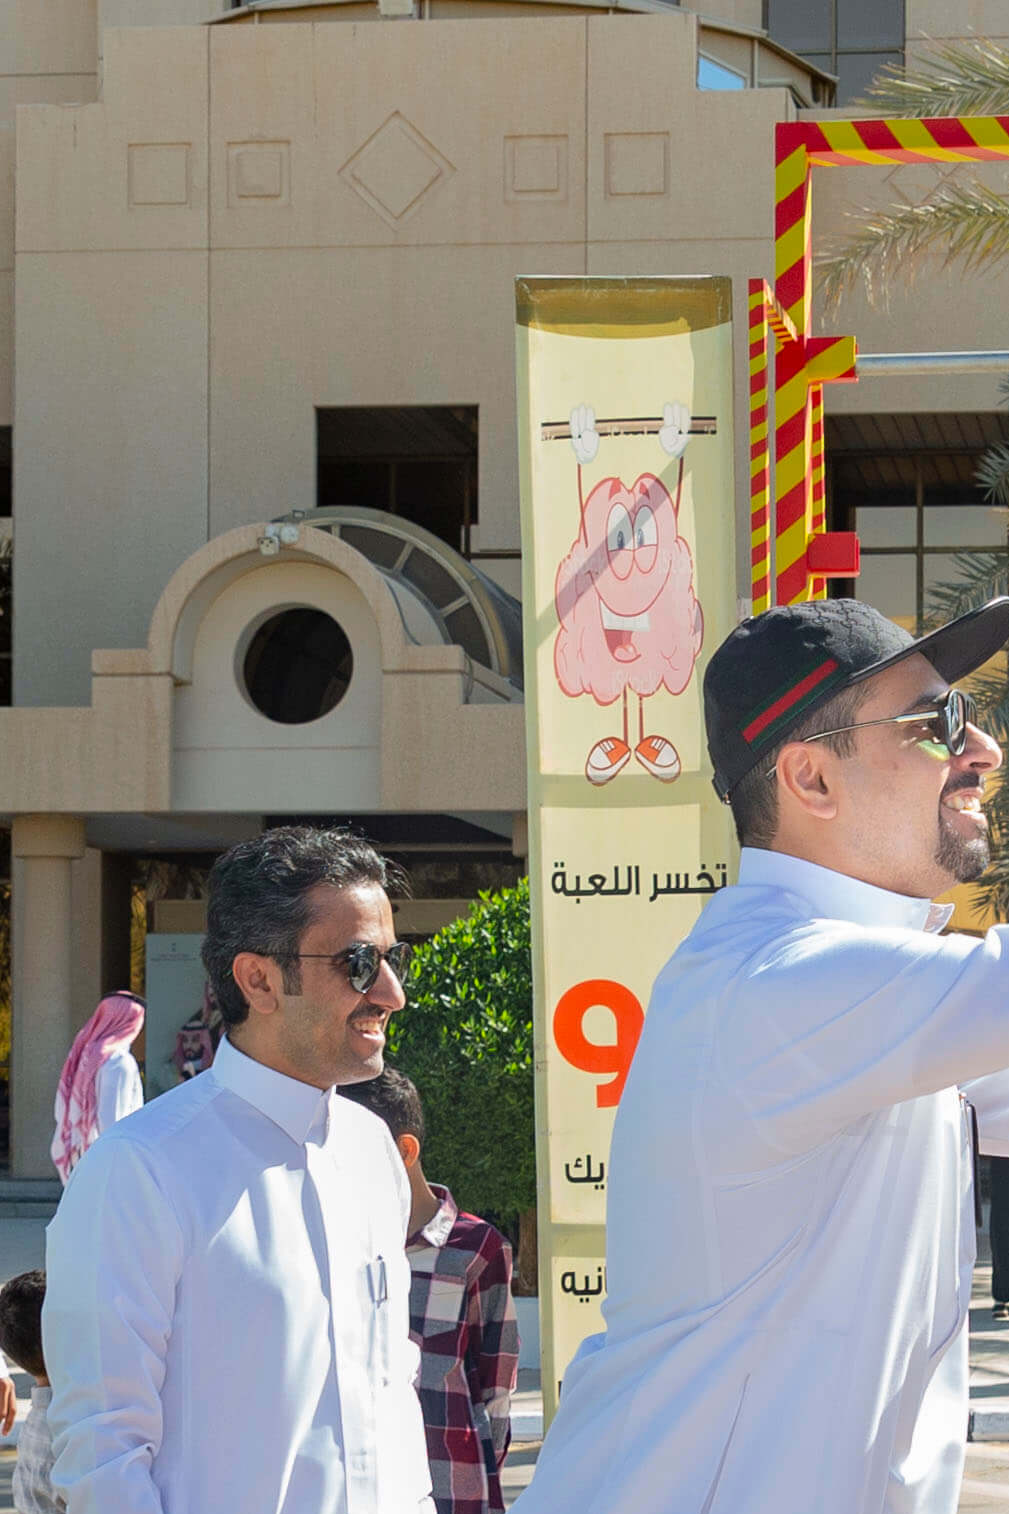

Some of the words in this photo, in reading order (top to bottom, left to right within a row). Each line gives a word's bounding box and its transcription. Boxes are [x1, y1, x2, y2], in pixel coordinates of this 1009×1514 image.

[551, 861, 640, 904] اللعبة
[650, 863, 727, 903] تخسر
[553, 979, 644, 1108] و
